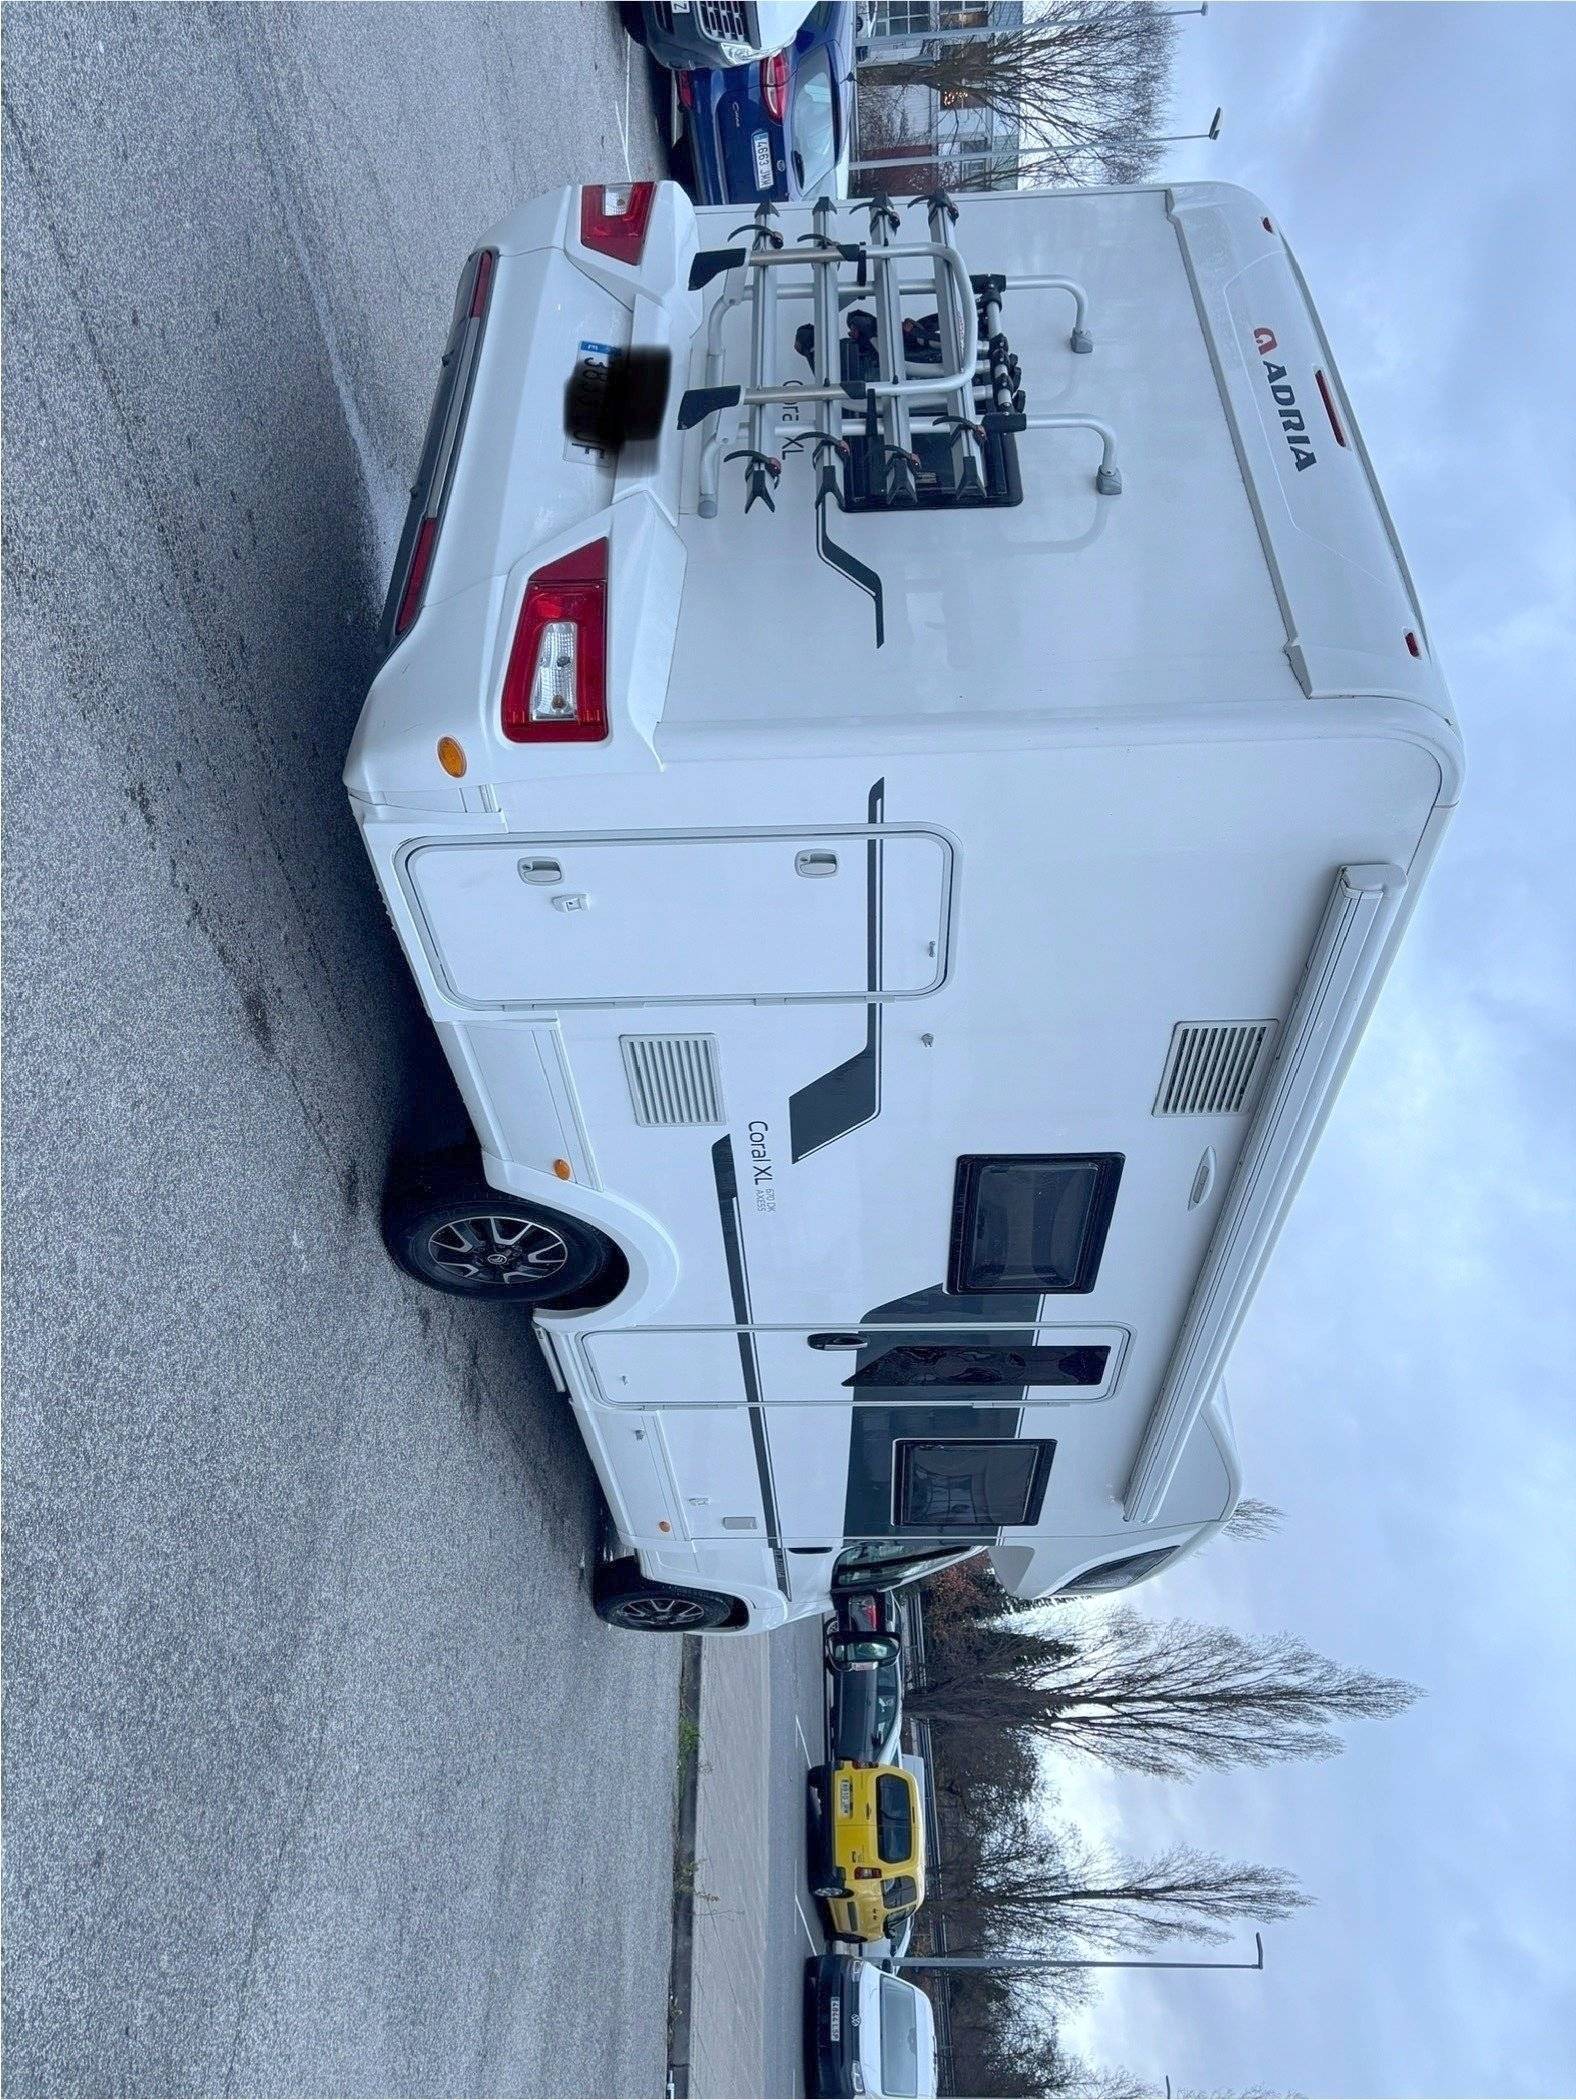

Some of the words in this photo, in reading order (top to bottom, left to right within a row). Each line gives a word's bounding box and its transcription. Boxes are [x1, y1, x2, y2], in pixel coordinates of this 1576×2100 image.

[756, 141, 770, 165] 4663
[1263, 361, 1317, 472] ADRIA
[748, 1120, 772, 1162] Coral
[752, 1166, 773, 1185] XL
